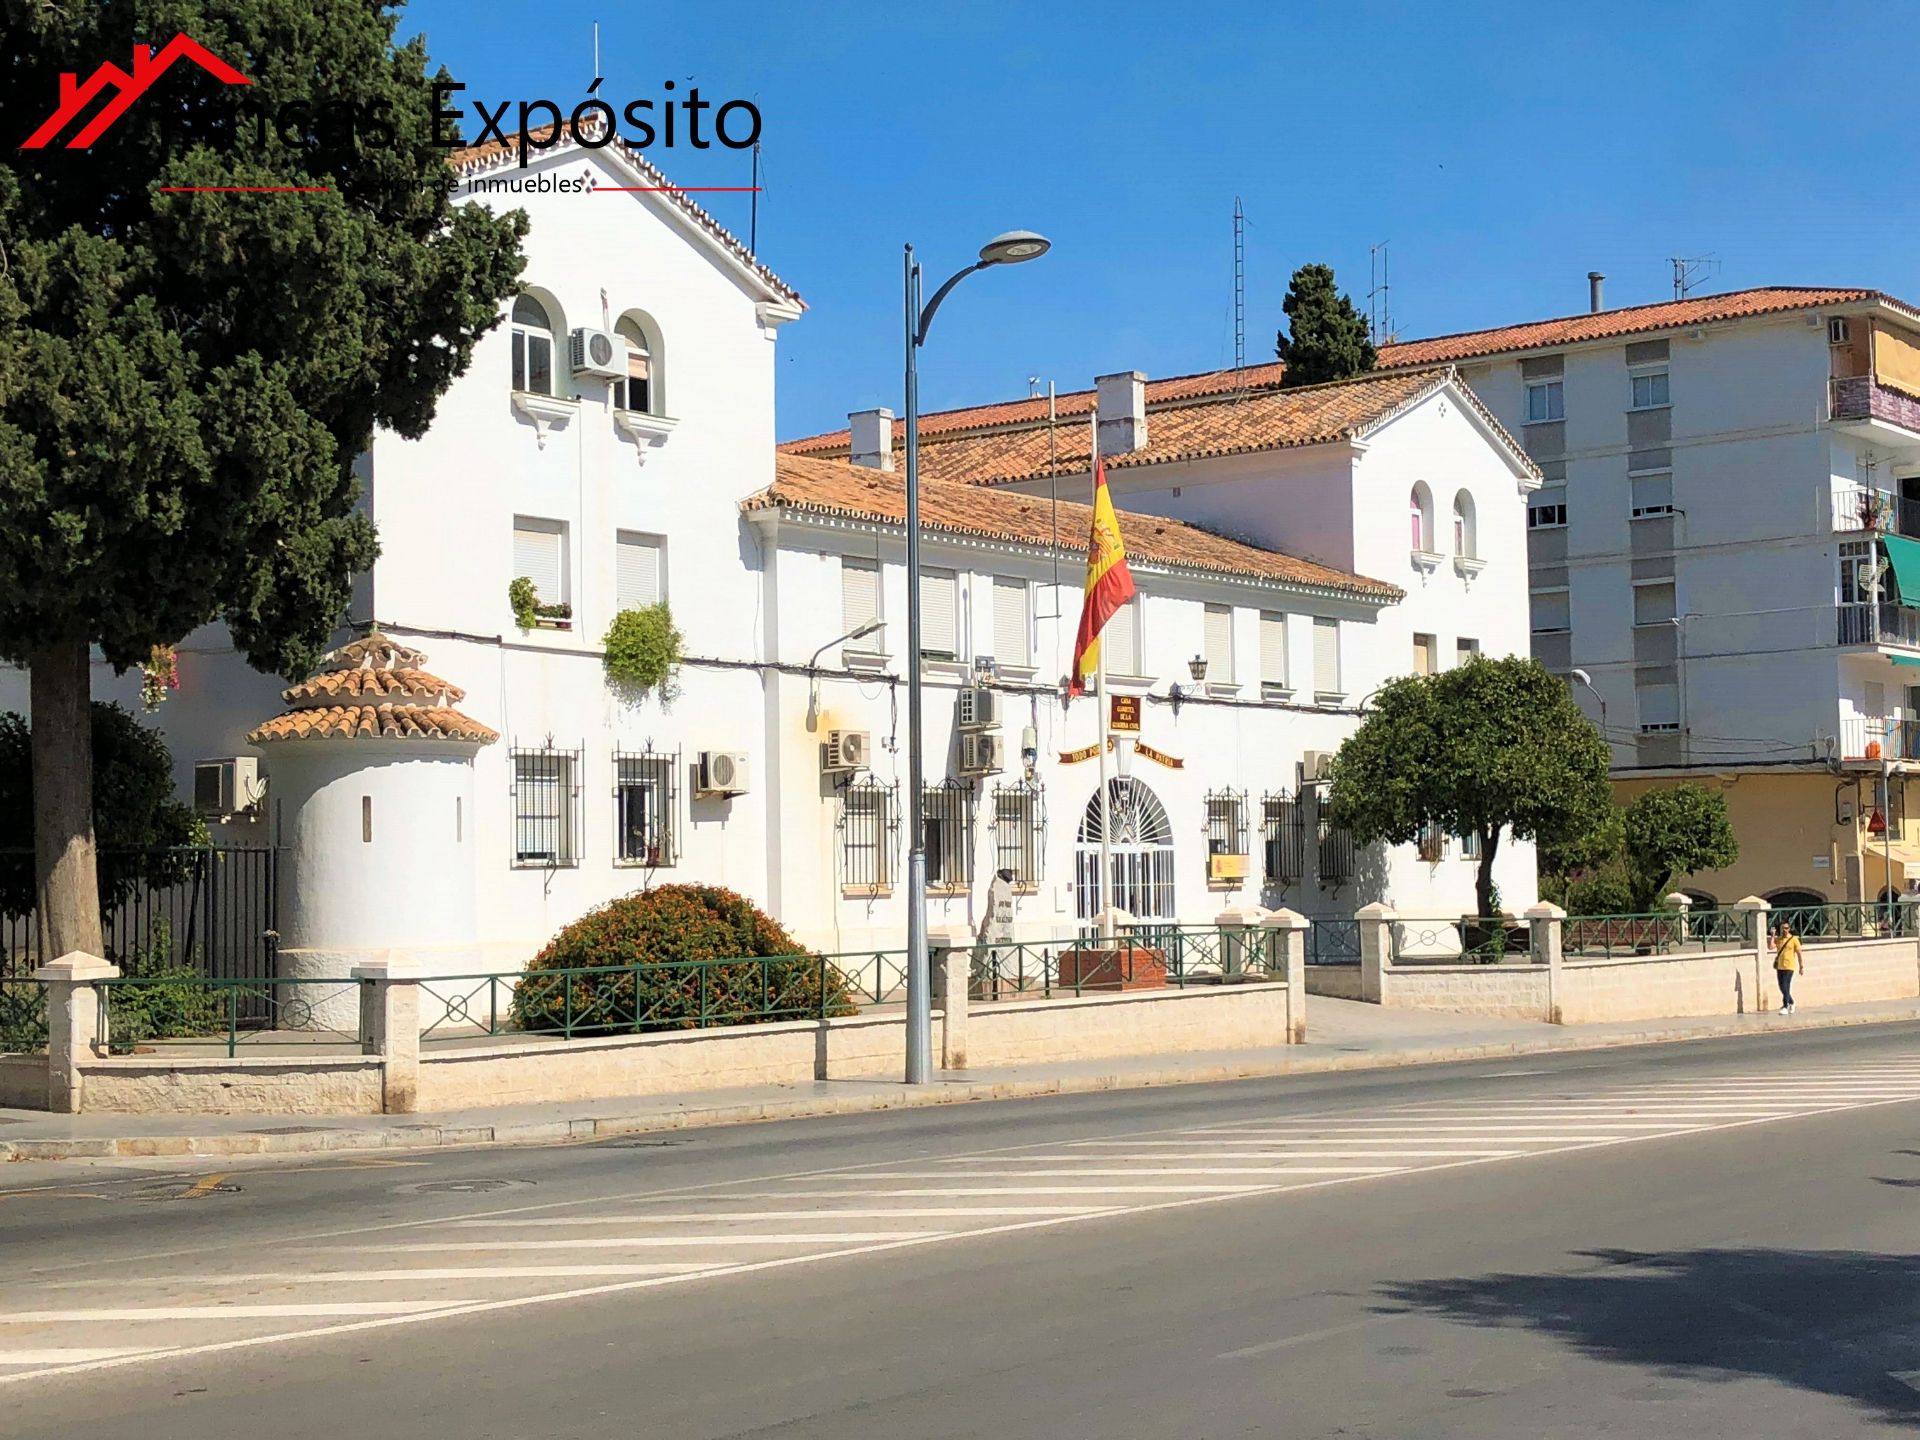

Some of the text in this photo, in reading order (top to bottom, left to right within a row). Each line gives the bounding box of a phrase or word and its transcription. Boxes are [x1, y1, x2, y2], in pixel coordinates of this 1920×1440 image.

[1072, 750, 1087, 763] TODO
[1145, 748, 1153, 759] LA
[1155, 752, 1174, 767] PATRIA
